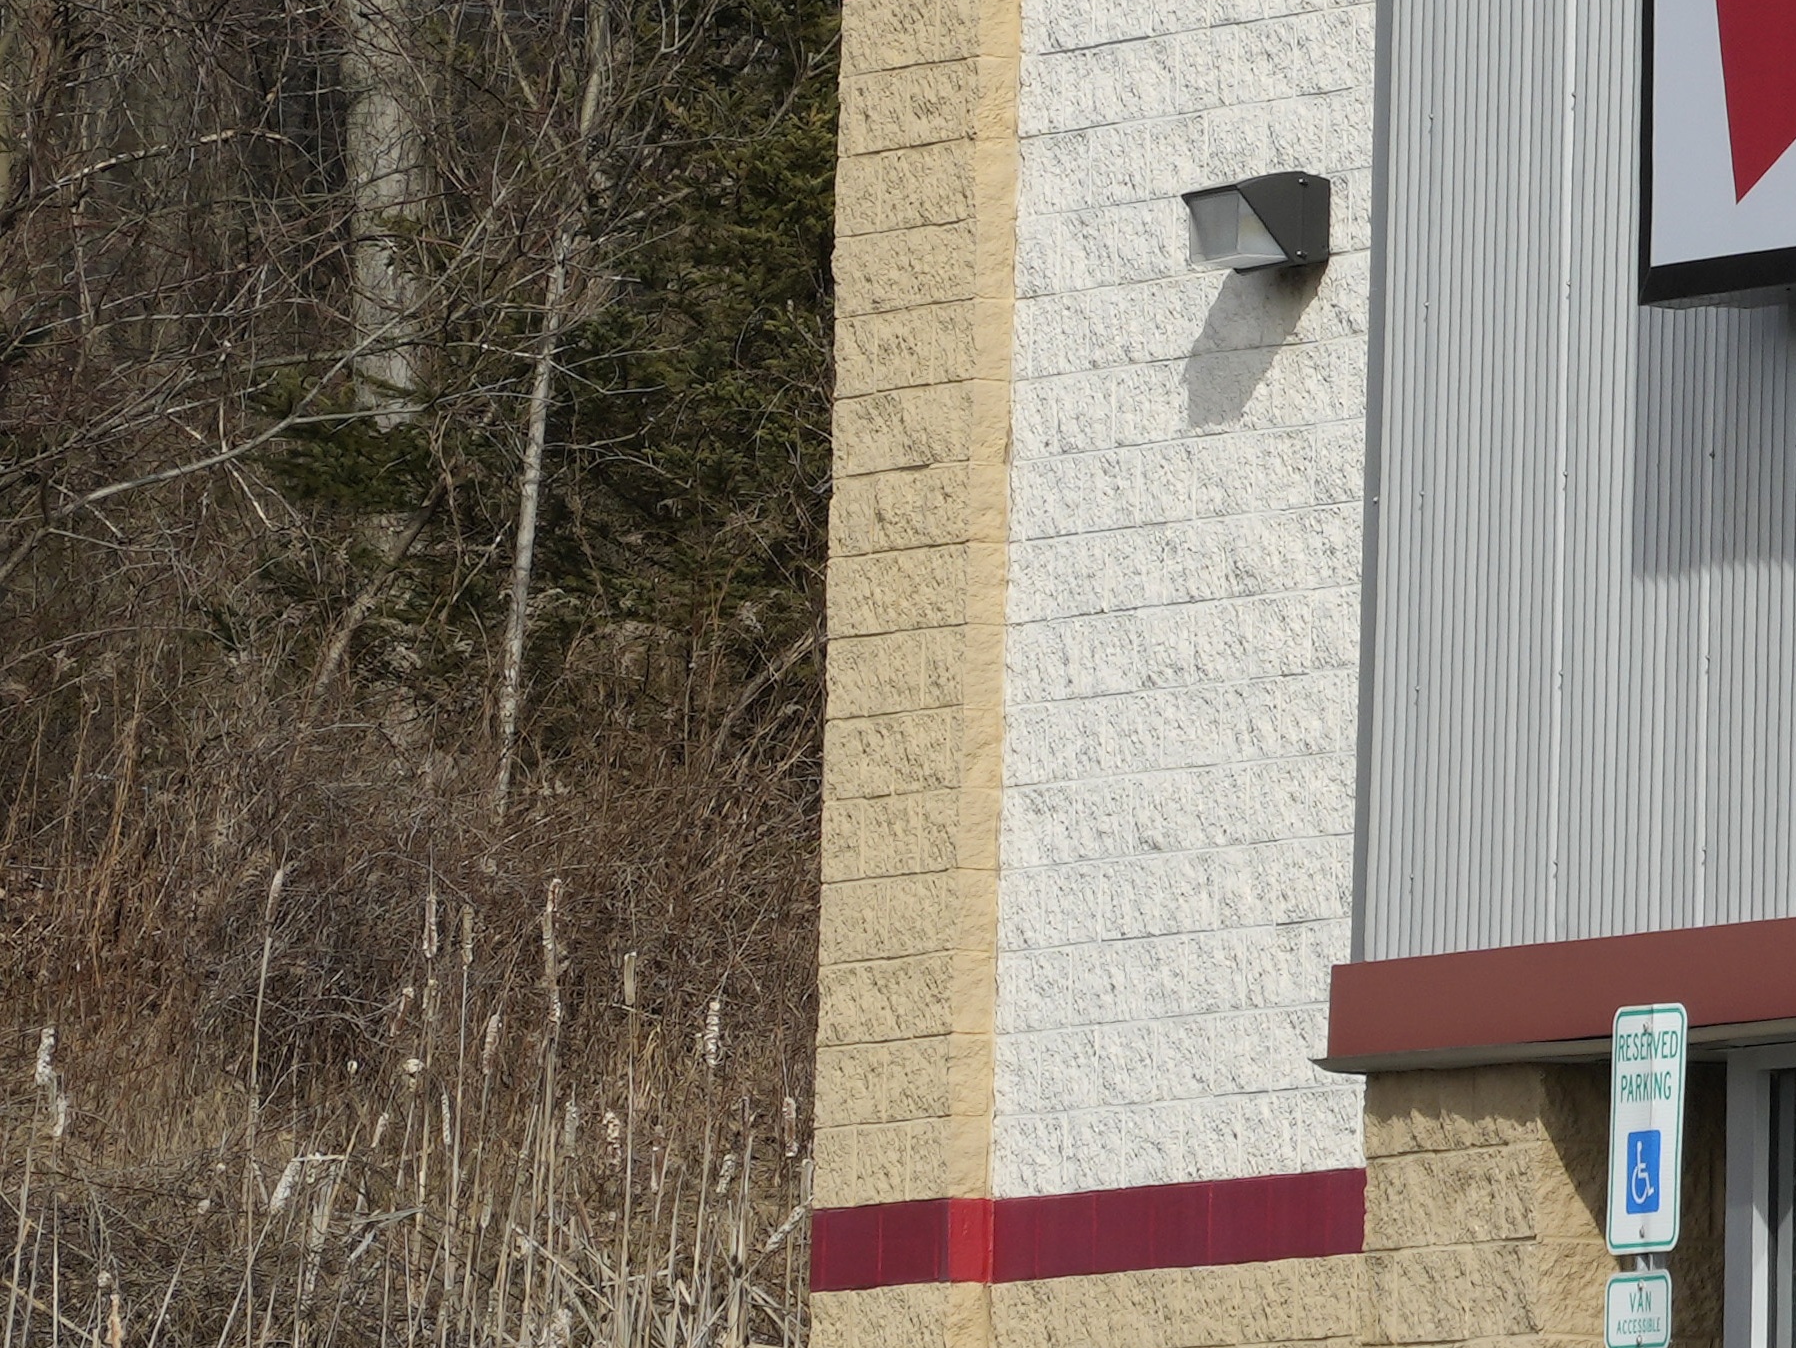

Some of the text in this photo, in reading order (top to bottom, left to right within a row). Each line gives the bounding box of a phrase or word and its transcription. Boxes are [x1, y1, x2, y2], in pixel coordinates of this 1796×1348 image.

[1617, 1030, 1679, 1063] RESERVED
[1620, 1070, 1672, 1104] PARKING
[1629, 1291, 1652, 1313] VAN
[1616, 1317, 1661, 1335] ACCESSIBLE
